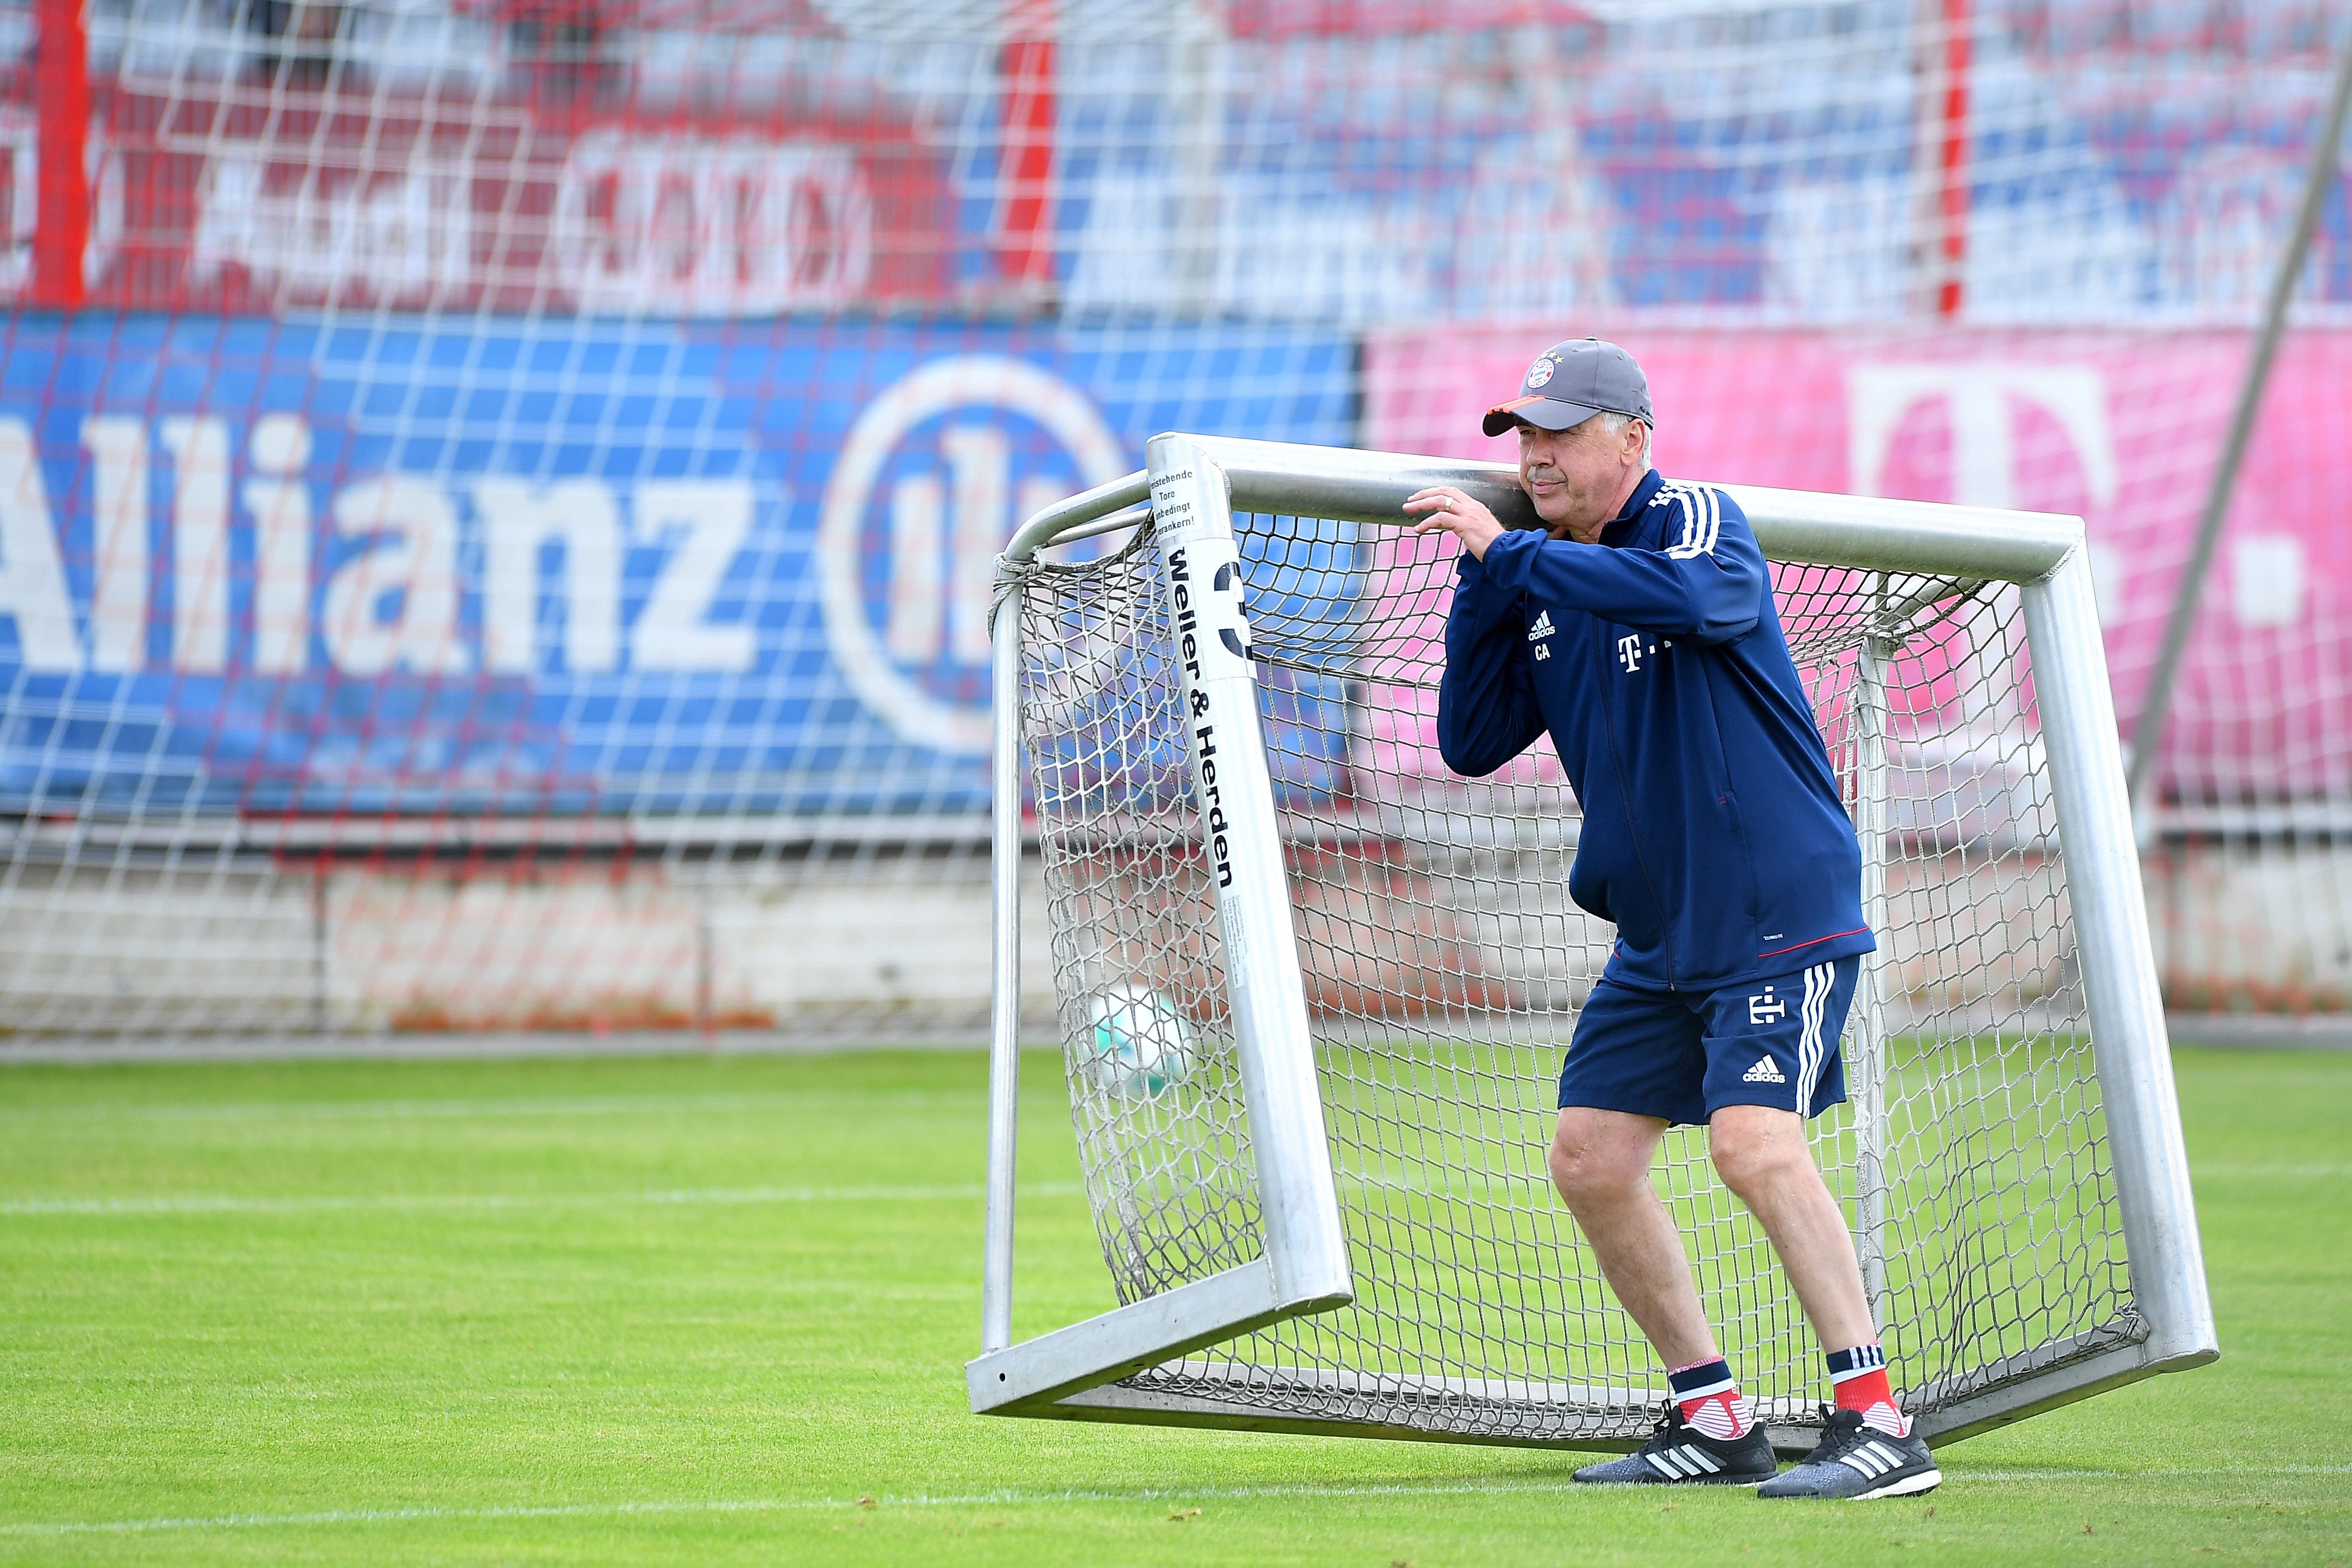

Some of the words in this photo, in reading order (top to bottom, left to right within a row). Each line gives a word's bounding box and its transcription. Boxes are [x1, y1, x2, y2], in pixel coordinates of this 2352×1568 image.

[1150, 470, 1193, 489] eistehende
[1159, 491, 1175, 501] Tore
[1157, 515, 1194, 535] erankern!
[1528, 626, 1556, 641] adidas
[1535, 643, 1551, 661] CA
[1190, 689, 1209, 722] &
[1196, 725, 1233, 890] Herden
[1742, 1071, 1786, 1083] adidas
